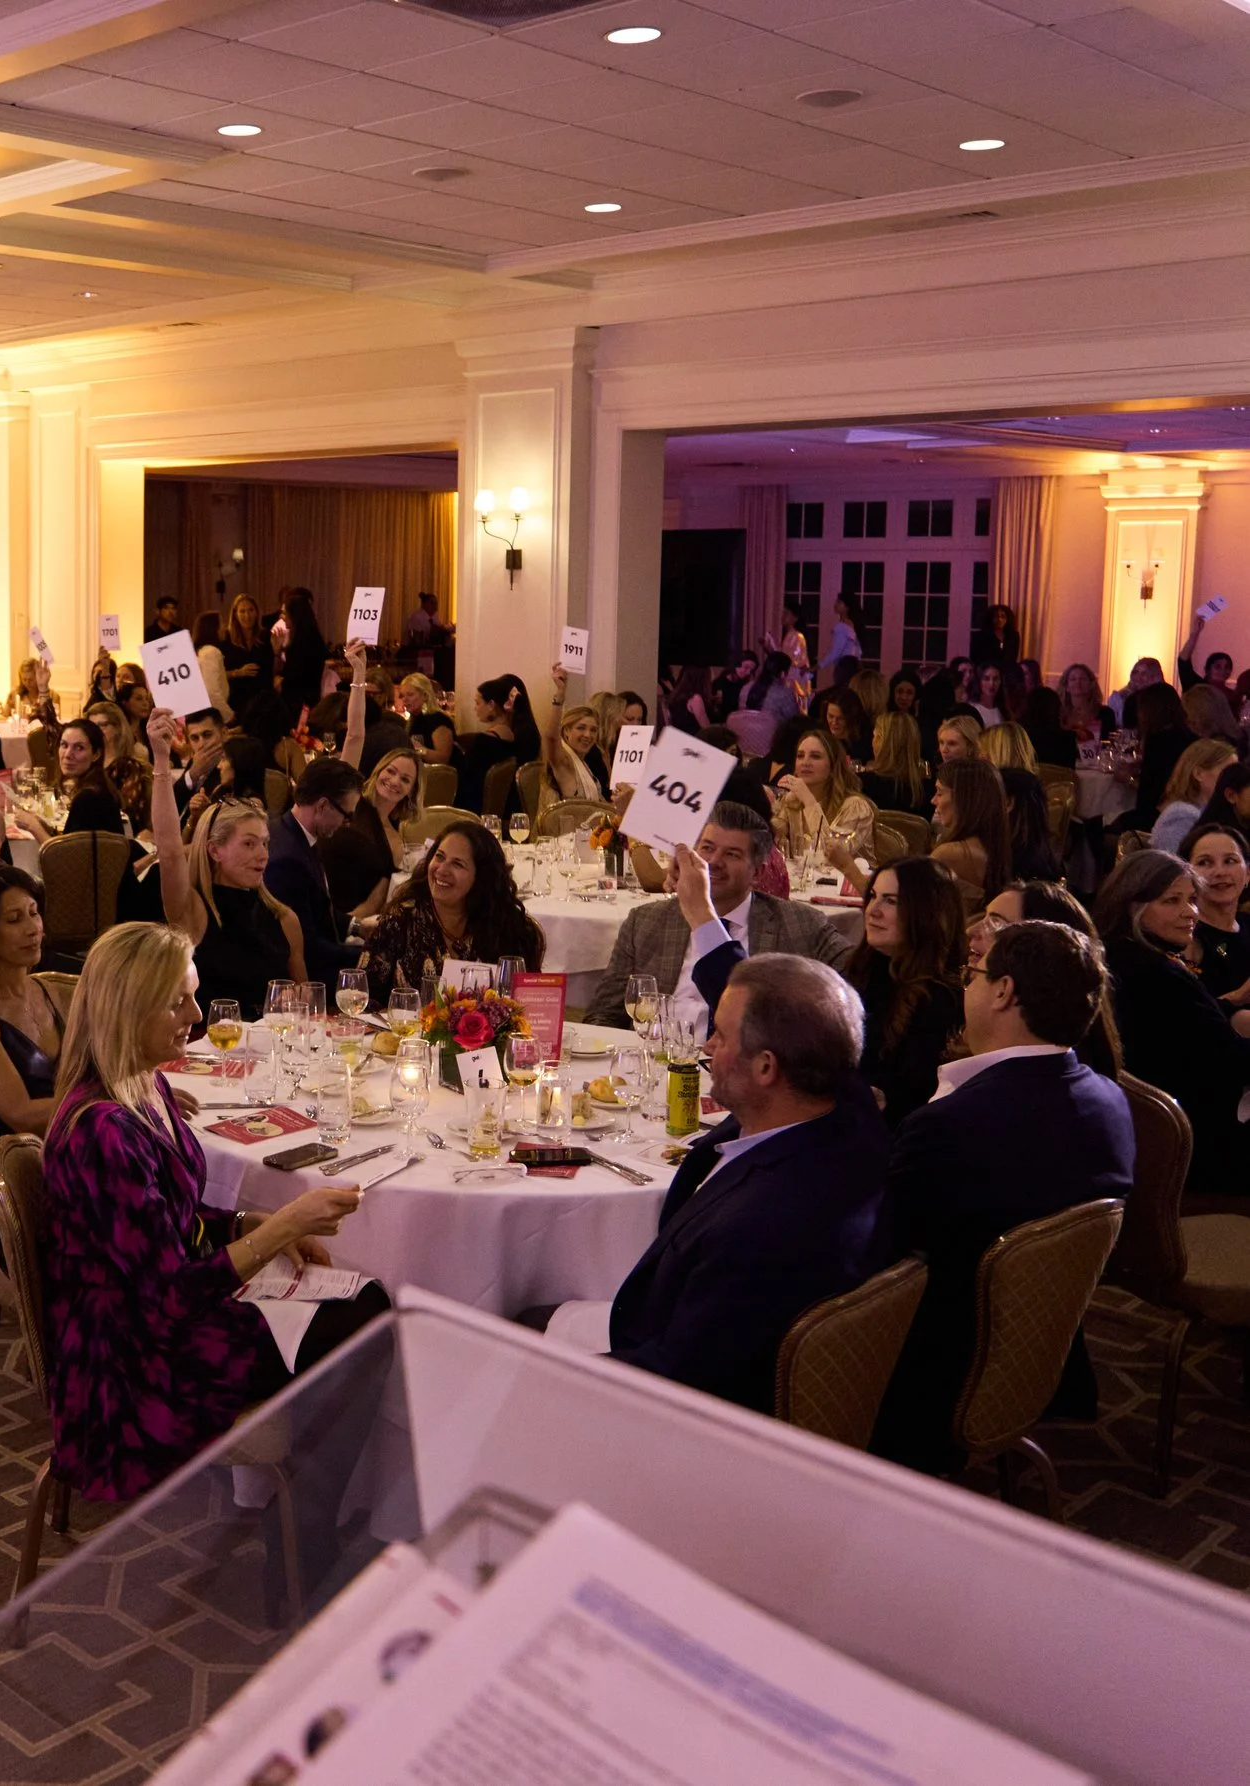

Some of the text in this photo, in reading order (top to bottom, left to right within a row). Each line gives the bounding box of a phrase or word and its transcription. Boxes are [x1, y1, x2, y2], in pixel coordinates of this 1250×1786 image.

[353, 609, 378, 621] 1103
[102, 628, 118, 637] 1701
[564, 644, 583, 656] 1911
[157, 663, 190, 685] 410
[619, 750, 644, 763] 1101
[648, 774, 703, 813] 404
